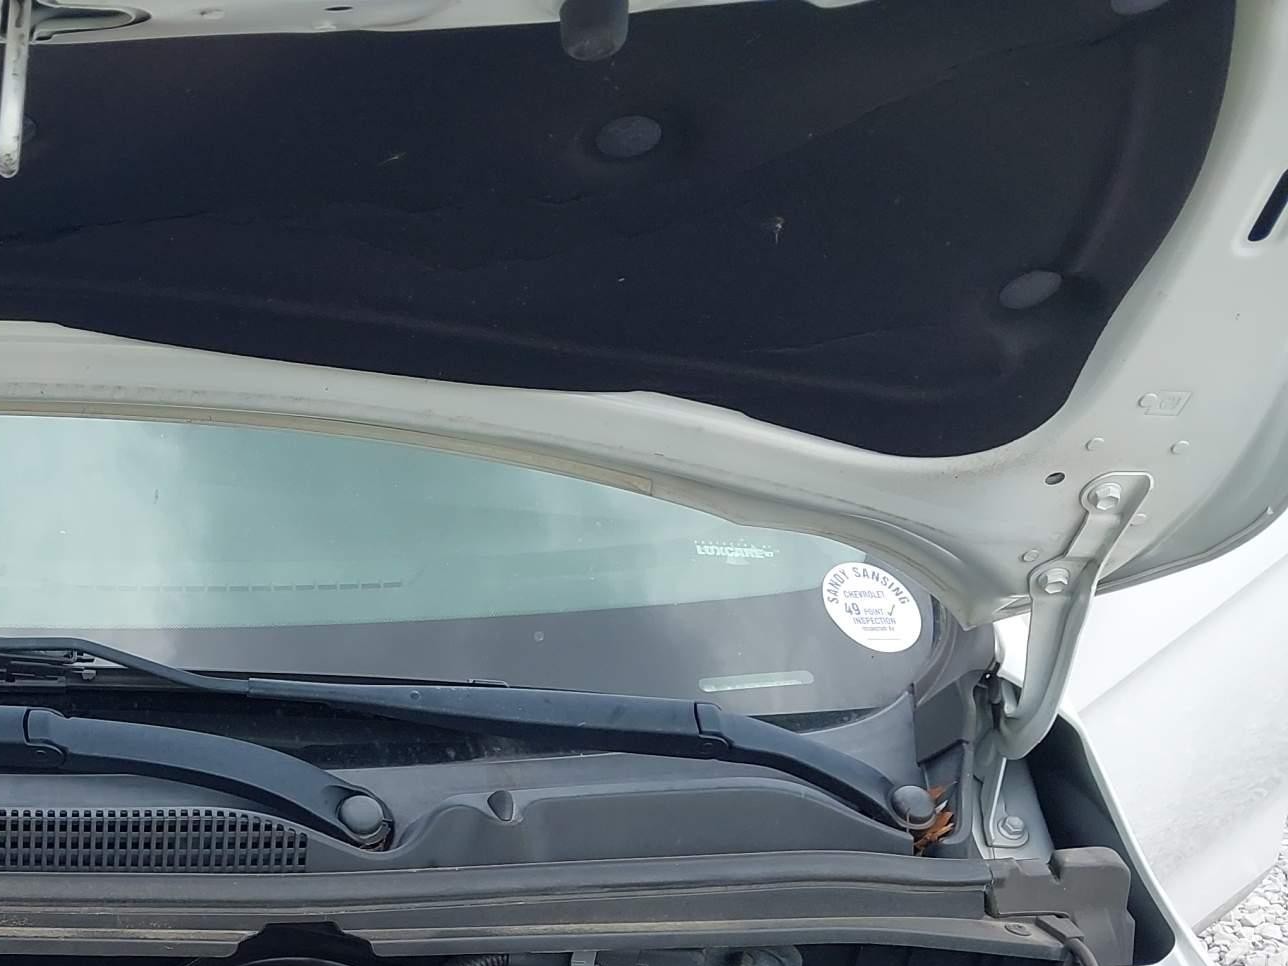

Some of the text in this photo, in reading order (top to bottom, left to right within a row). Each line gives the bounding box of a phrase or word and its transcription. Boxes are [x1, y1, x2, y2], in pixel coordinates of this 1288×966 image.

[826, 567, 910, 604] SANDY SANSING
[843, 590, 885, 599] CHEVROLET
[844, 602, 861, 615] 49
